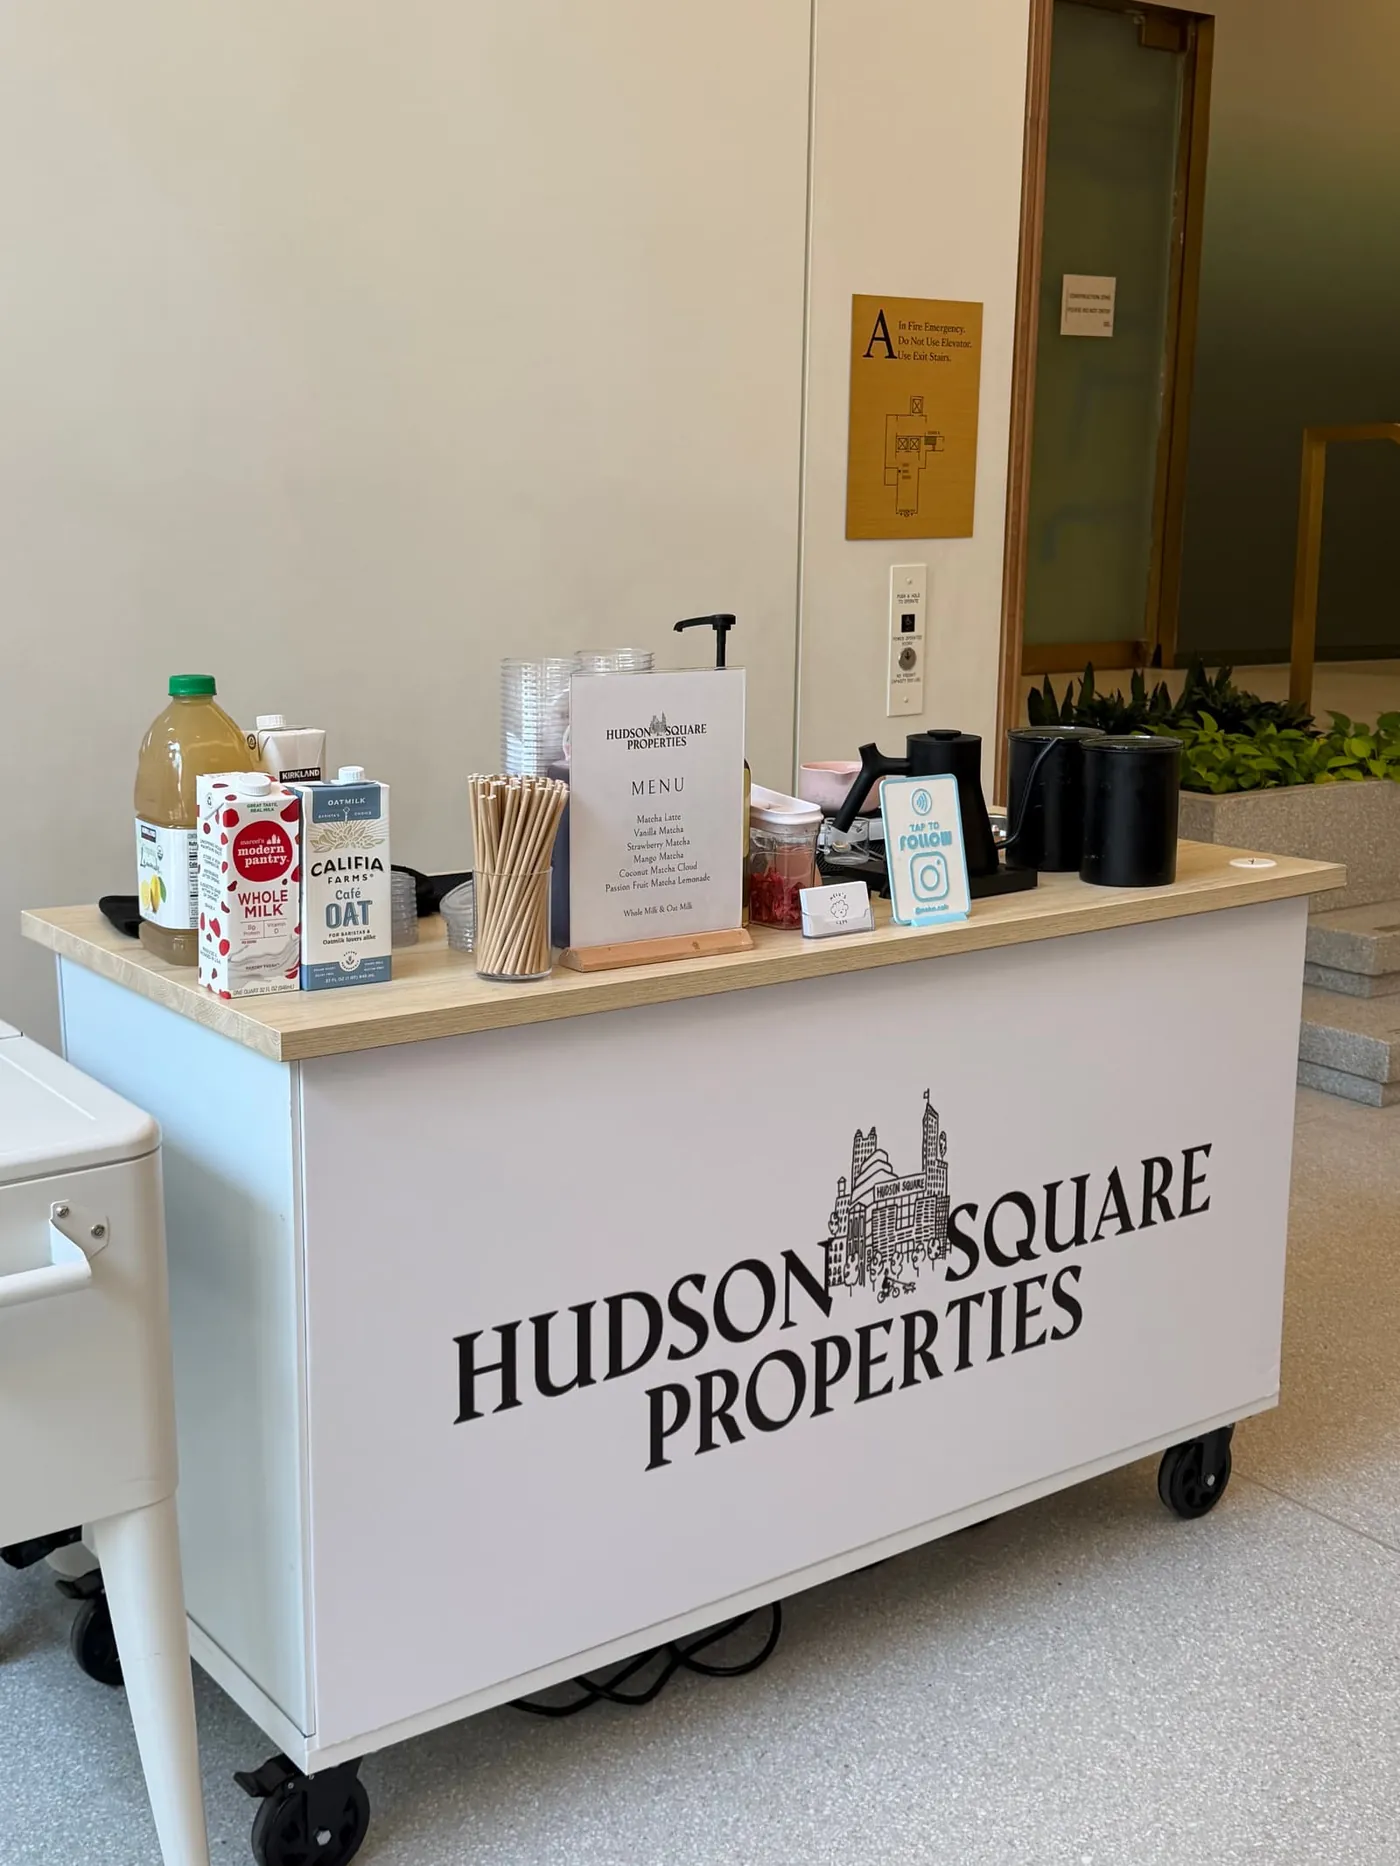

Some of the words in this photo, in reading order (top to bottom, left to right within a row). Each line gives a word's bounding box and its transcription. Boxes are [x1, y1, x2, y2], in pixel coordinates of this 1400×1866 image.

[862, 308, 898, 359] A
[898, 320, 906, 330] In
[908, 321, 923, 332] Fire
[898, 336, 909, 345] Do
[911, 336, 925, 346] Not
[926, 337, 940, 347] Use
[897, 350, 911, 360] Use
[913, 351, 928, 361] Exit
[606, 727, 651, 740] HUDSON
[665, 723, 707, 736] SQUARE
[627, 736, 687, 750] PROPERTIES
[281, 769, 320, 780] KIRKLAND
[631, 777, 684, 796] MENU
[327, 797, 366, 806] OATMILK
[637, 813, 662, 824] Matcha
[664, 812, 682, 822] Latte
[634, 826, 657, 837] Vanilla
[659, 825, 684, 835] Matcha
[908, 823, 926, 832] TAP
[928, 821, 940, 830] TO
[627, 840, 663, 851] Strawberry
[665, 836, 691, 847] Matcha
[899, 830, 953, 851] FOLLOW
[237, 845, 285, 856] modern
[633, 854, 657, 864] Mango
[659, 851, 684, 861] Matcha
[311, 856, 384, 877] CALIFIA
[619, 868, 648, 878] Coconut
[650, 864, 676, 875] Matcha
[677, 861, 698, 872] Cloud
[605, 883, 630, 893] Passion
[632, 880, 649, 890] Fruit
[651, 876, 676, 887] Matcha
[677, 872, 711, 885] Lemonade
[237, 889, 288, 906] WHOLE
[335, 887, 361, 900] Café
[244, 903, 283, 919] MILK
[325, 900, 373, 929] OAT
[623, 908, 643, 917] Whole
[644, 906, 658, 915] Milk
[659, 905, 665, 913] &
[666, 904, 678, 912] Oat
[679, 902, 693, 910] Milk
[877, 1183, 901, 1199] HUDSON
[901, 1178, 925, 1192] SQUARE
[452, 1238, 833, 1425] HUDSON
[945, 1142, 1213, 1282] SQUARE
[643, 1265, 1083, 1473] PROPERTIES
